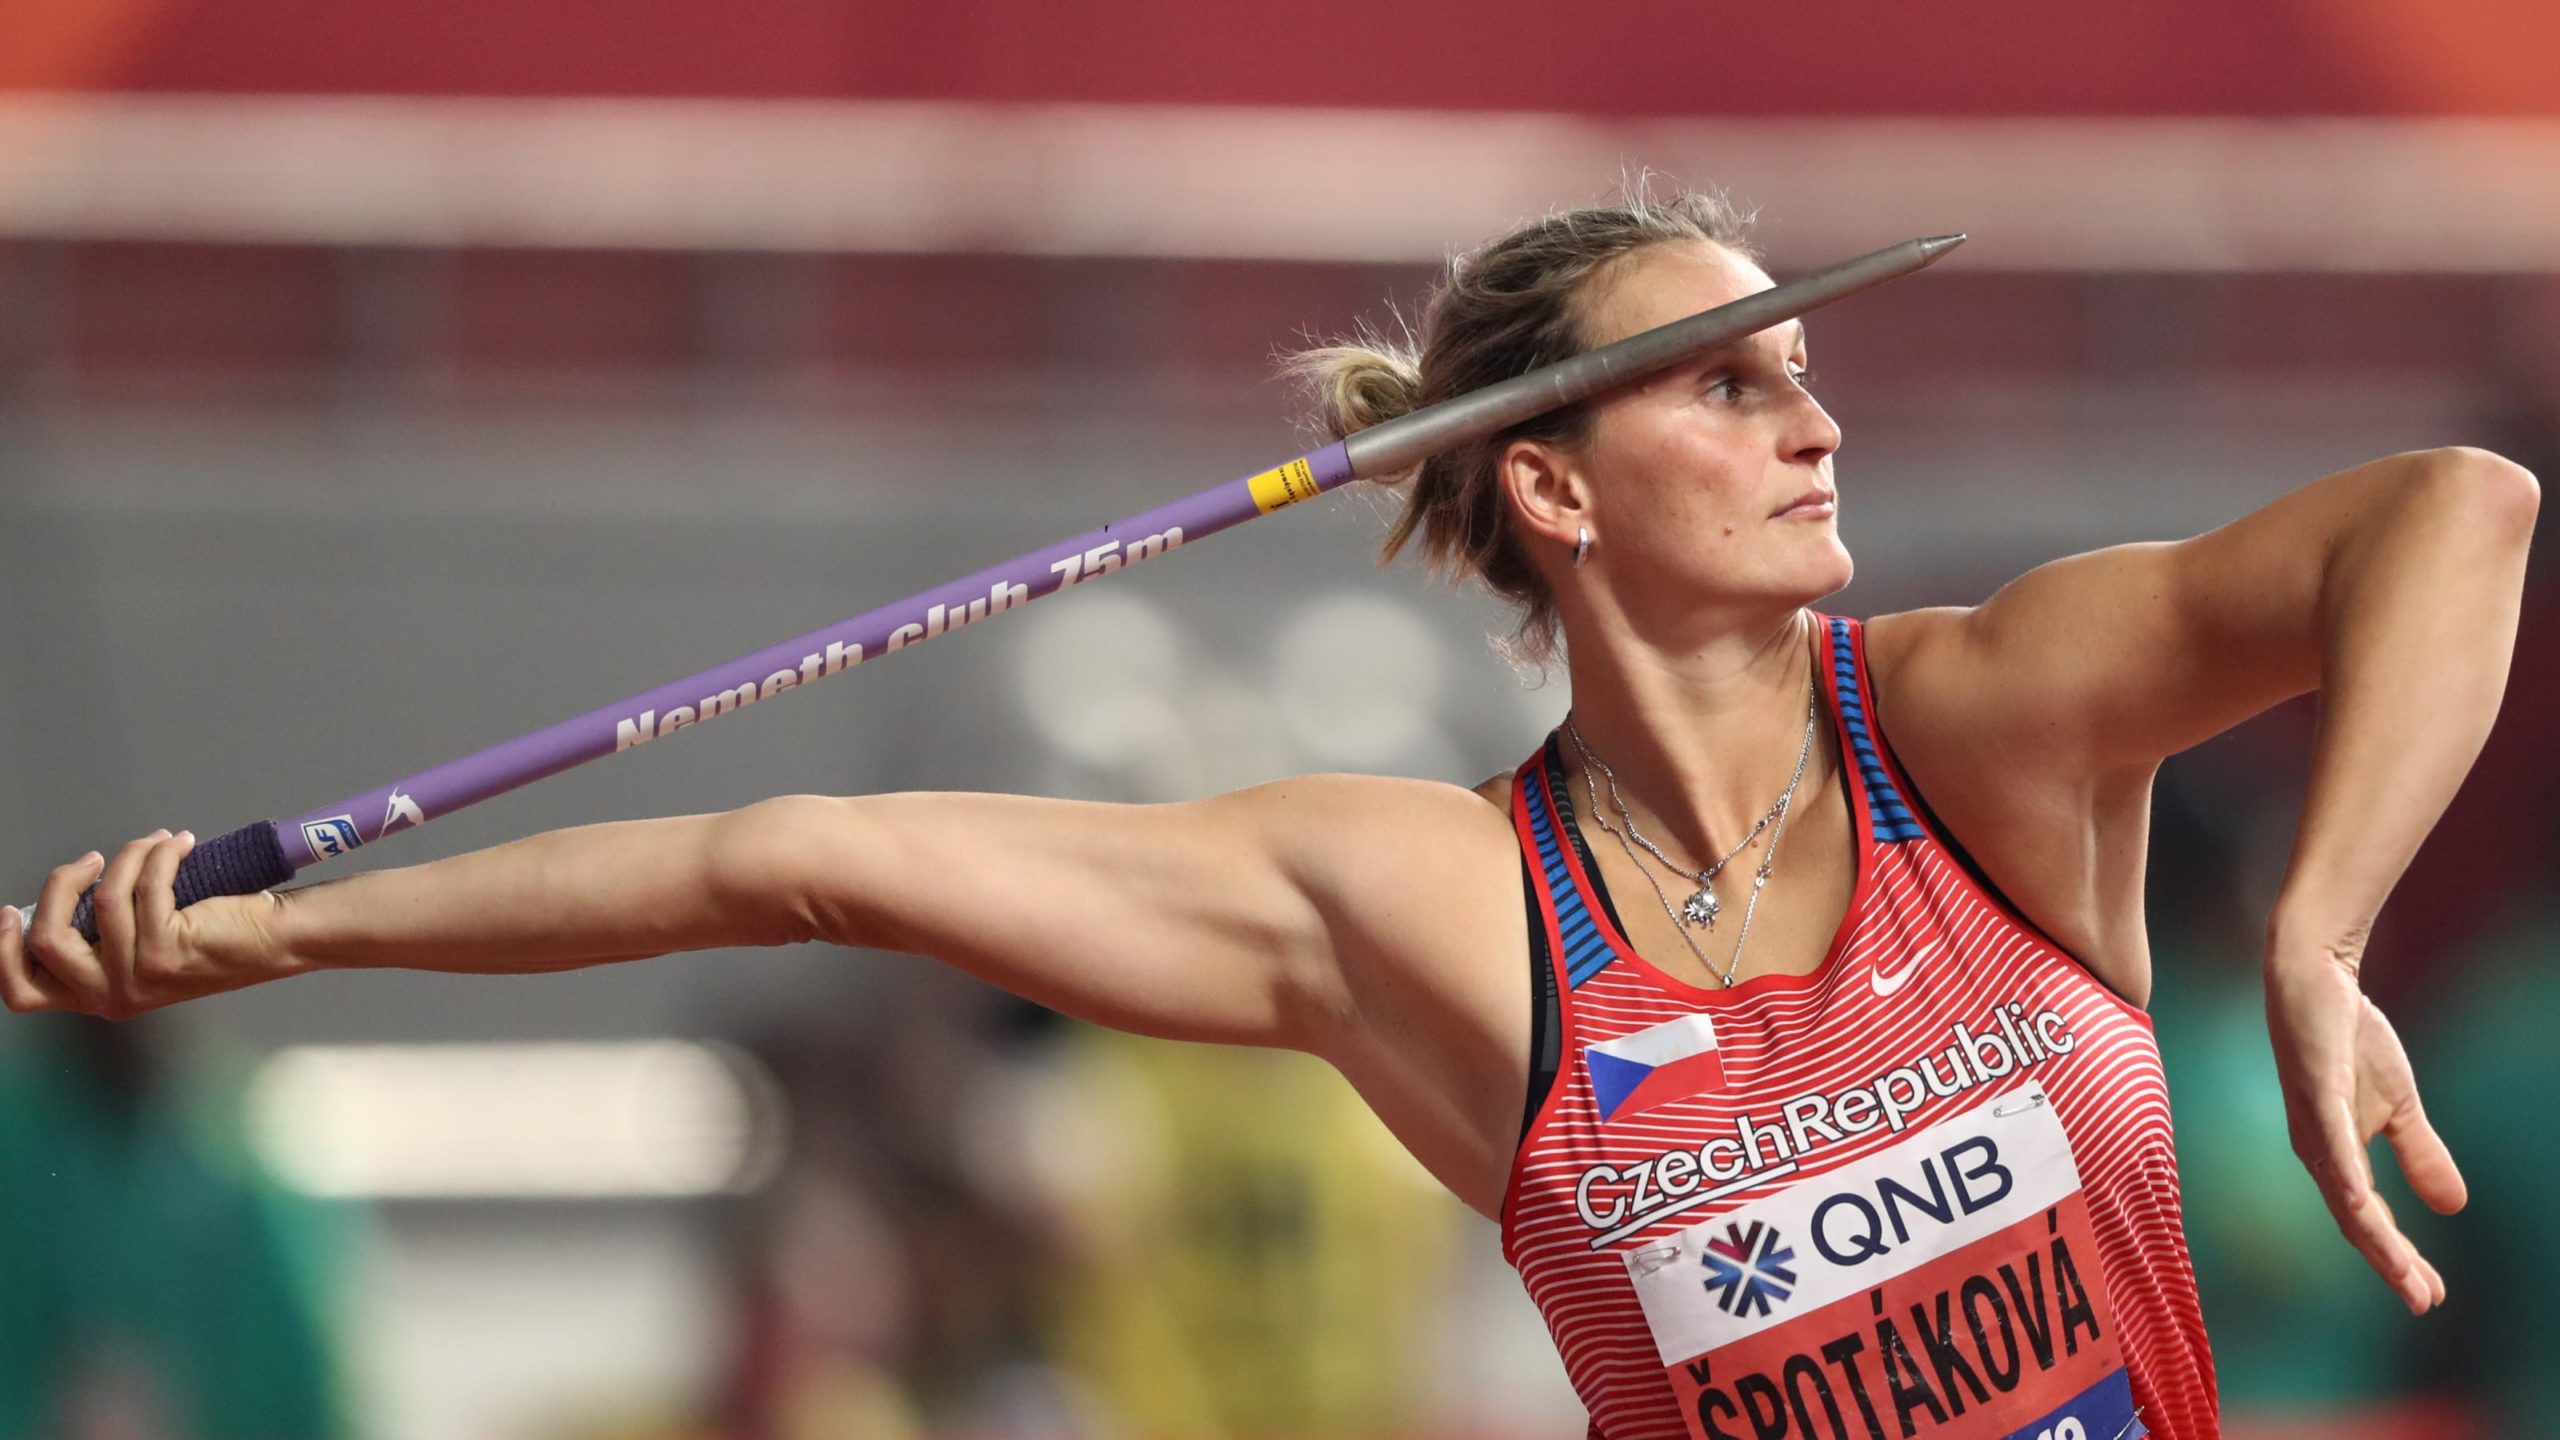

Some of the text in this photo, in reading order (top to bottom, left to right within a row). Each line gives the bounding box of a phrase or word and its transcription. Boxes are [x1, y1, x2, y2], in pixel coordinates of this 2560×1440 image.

[616, 526, 1184, 753] Nemeth club 75m
[1576, 1000, 2076, 1231] CzechRepublic
[1810, 1135, 2014, 1268] QNB
